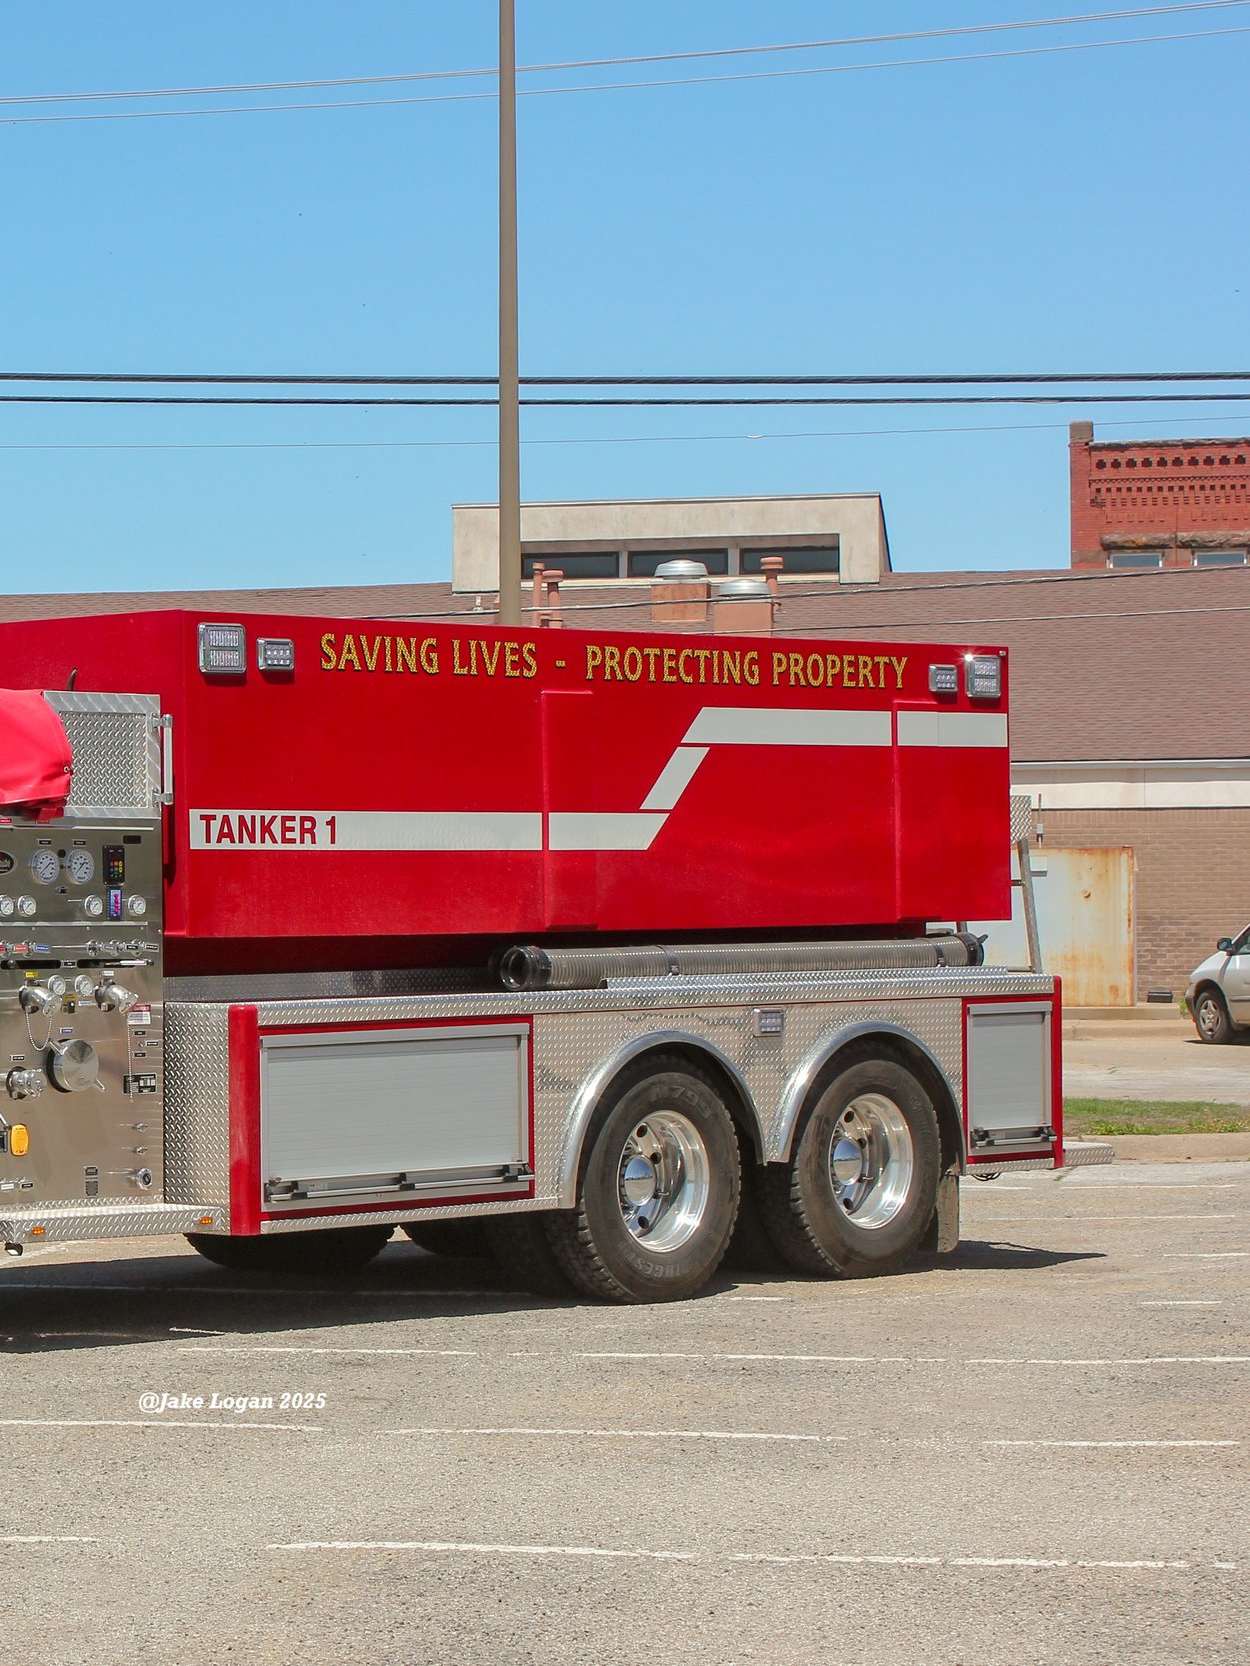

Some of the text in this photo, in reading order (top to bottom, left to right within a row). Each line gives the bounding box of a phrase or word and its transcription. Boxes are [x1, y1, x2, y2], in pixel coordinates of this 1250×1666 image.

[320, 633, 440, 675] SAVING
[452, 639, 538, 679] LIVES
[585, 645, 760, 686] PROTECTING
[772, 651, 909, 690] PROPERTY
[199, 814, 336, 845] TANKER 1
